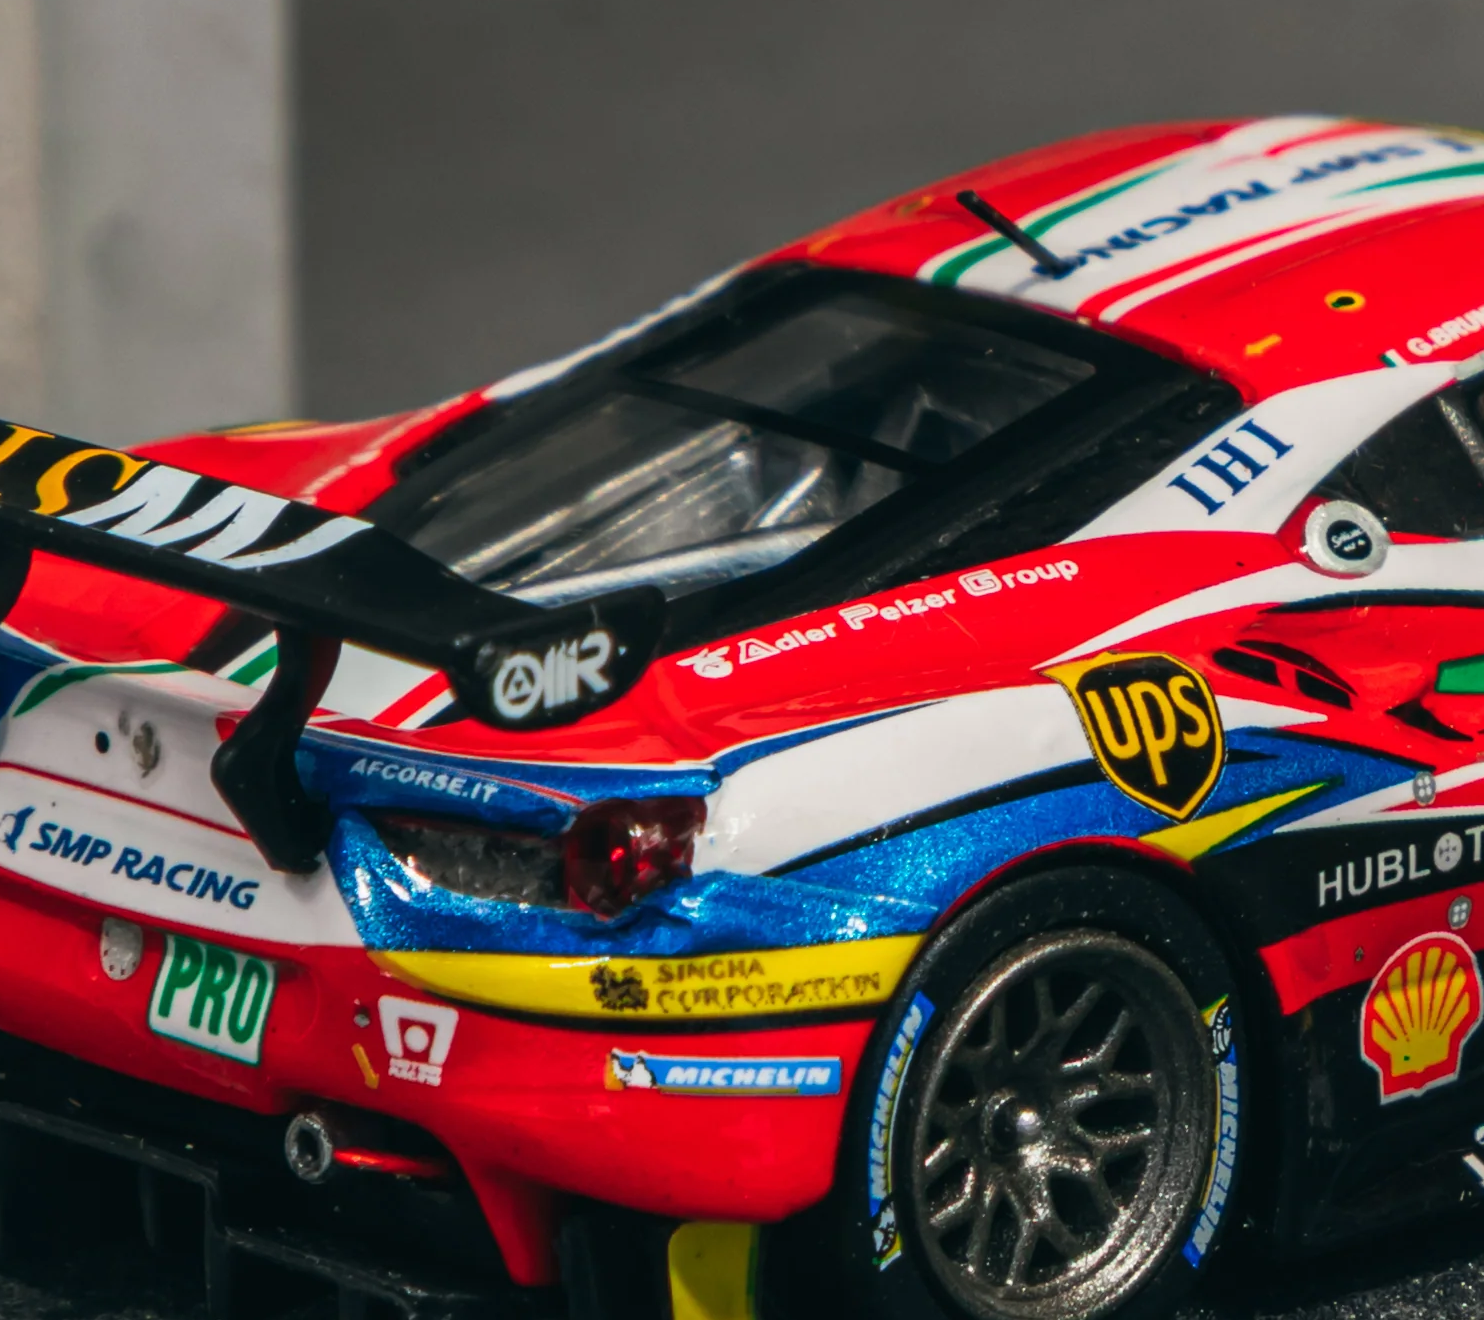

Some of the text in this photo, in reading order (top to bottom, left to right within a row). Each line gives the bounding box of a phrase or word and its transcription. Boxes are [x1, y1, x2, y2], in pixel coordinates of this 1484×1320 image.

[1166, 418, 1294, 515] IHI
[738, 558, 1080, 666] Adler Pelzer Group
[350, 756, 501, 804] AFCORSE.IT
[1087, 677, 1214, 788] ups
[30, 820, 260, 911] SMP RACING
[156, 937, 269, 1046] PRO
[654, 957, 766, 984] SINGHA
[664, 1064, 832, 1088] MICHELIN
[870, 1002, 924, 1201] MICHELIN
[1191, 1061, 1239, 1256] MICHELIN
